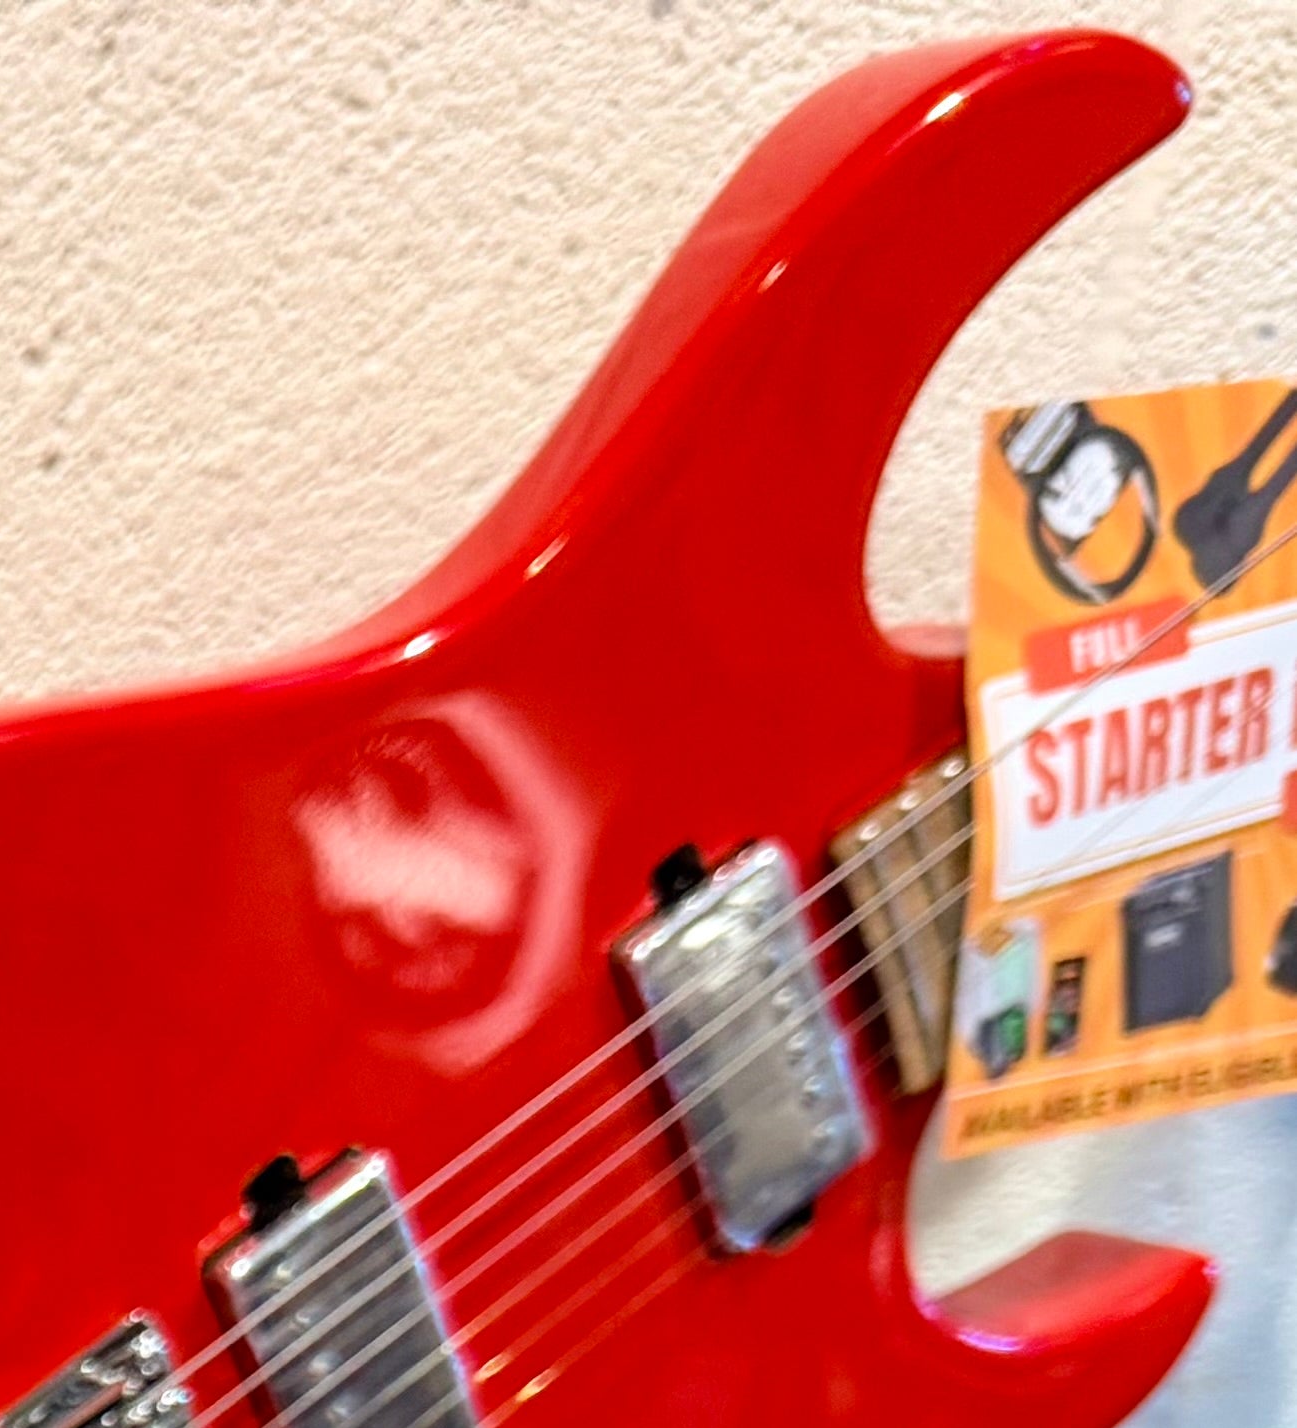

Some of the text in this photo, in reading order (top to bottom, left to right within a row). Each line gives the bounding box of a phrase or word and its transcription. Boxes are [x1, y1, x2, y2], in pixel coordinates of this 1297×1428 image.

[1069, 617, 1147, 673] FULL
[1026, 667, 1274, 826] STARTER
[960, 1047, 1297, 1137] AVAILABLE WITH ELIGIBL
